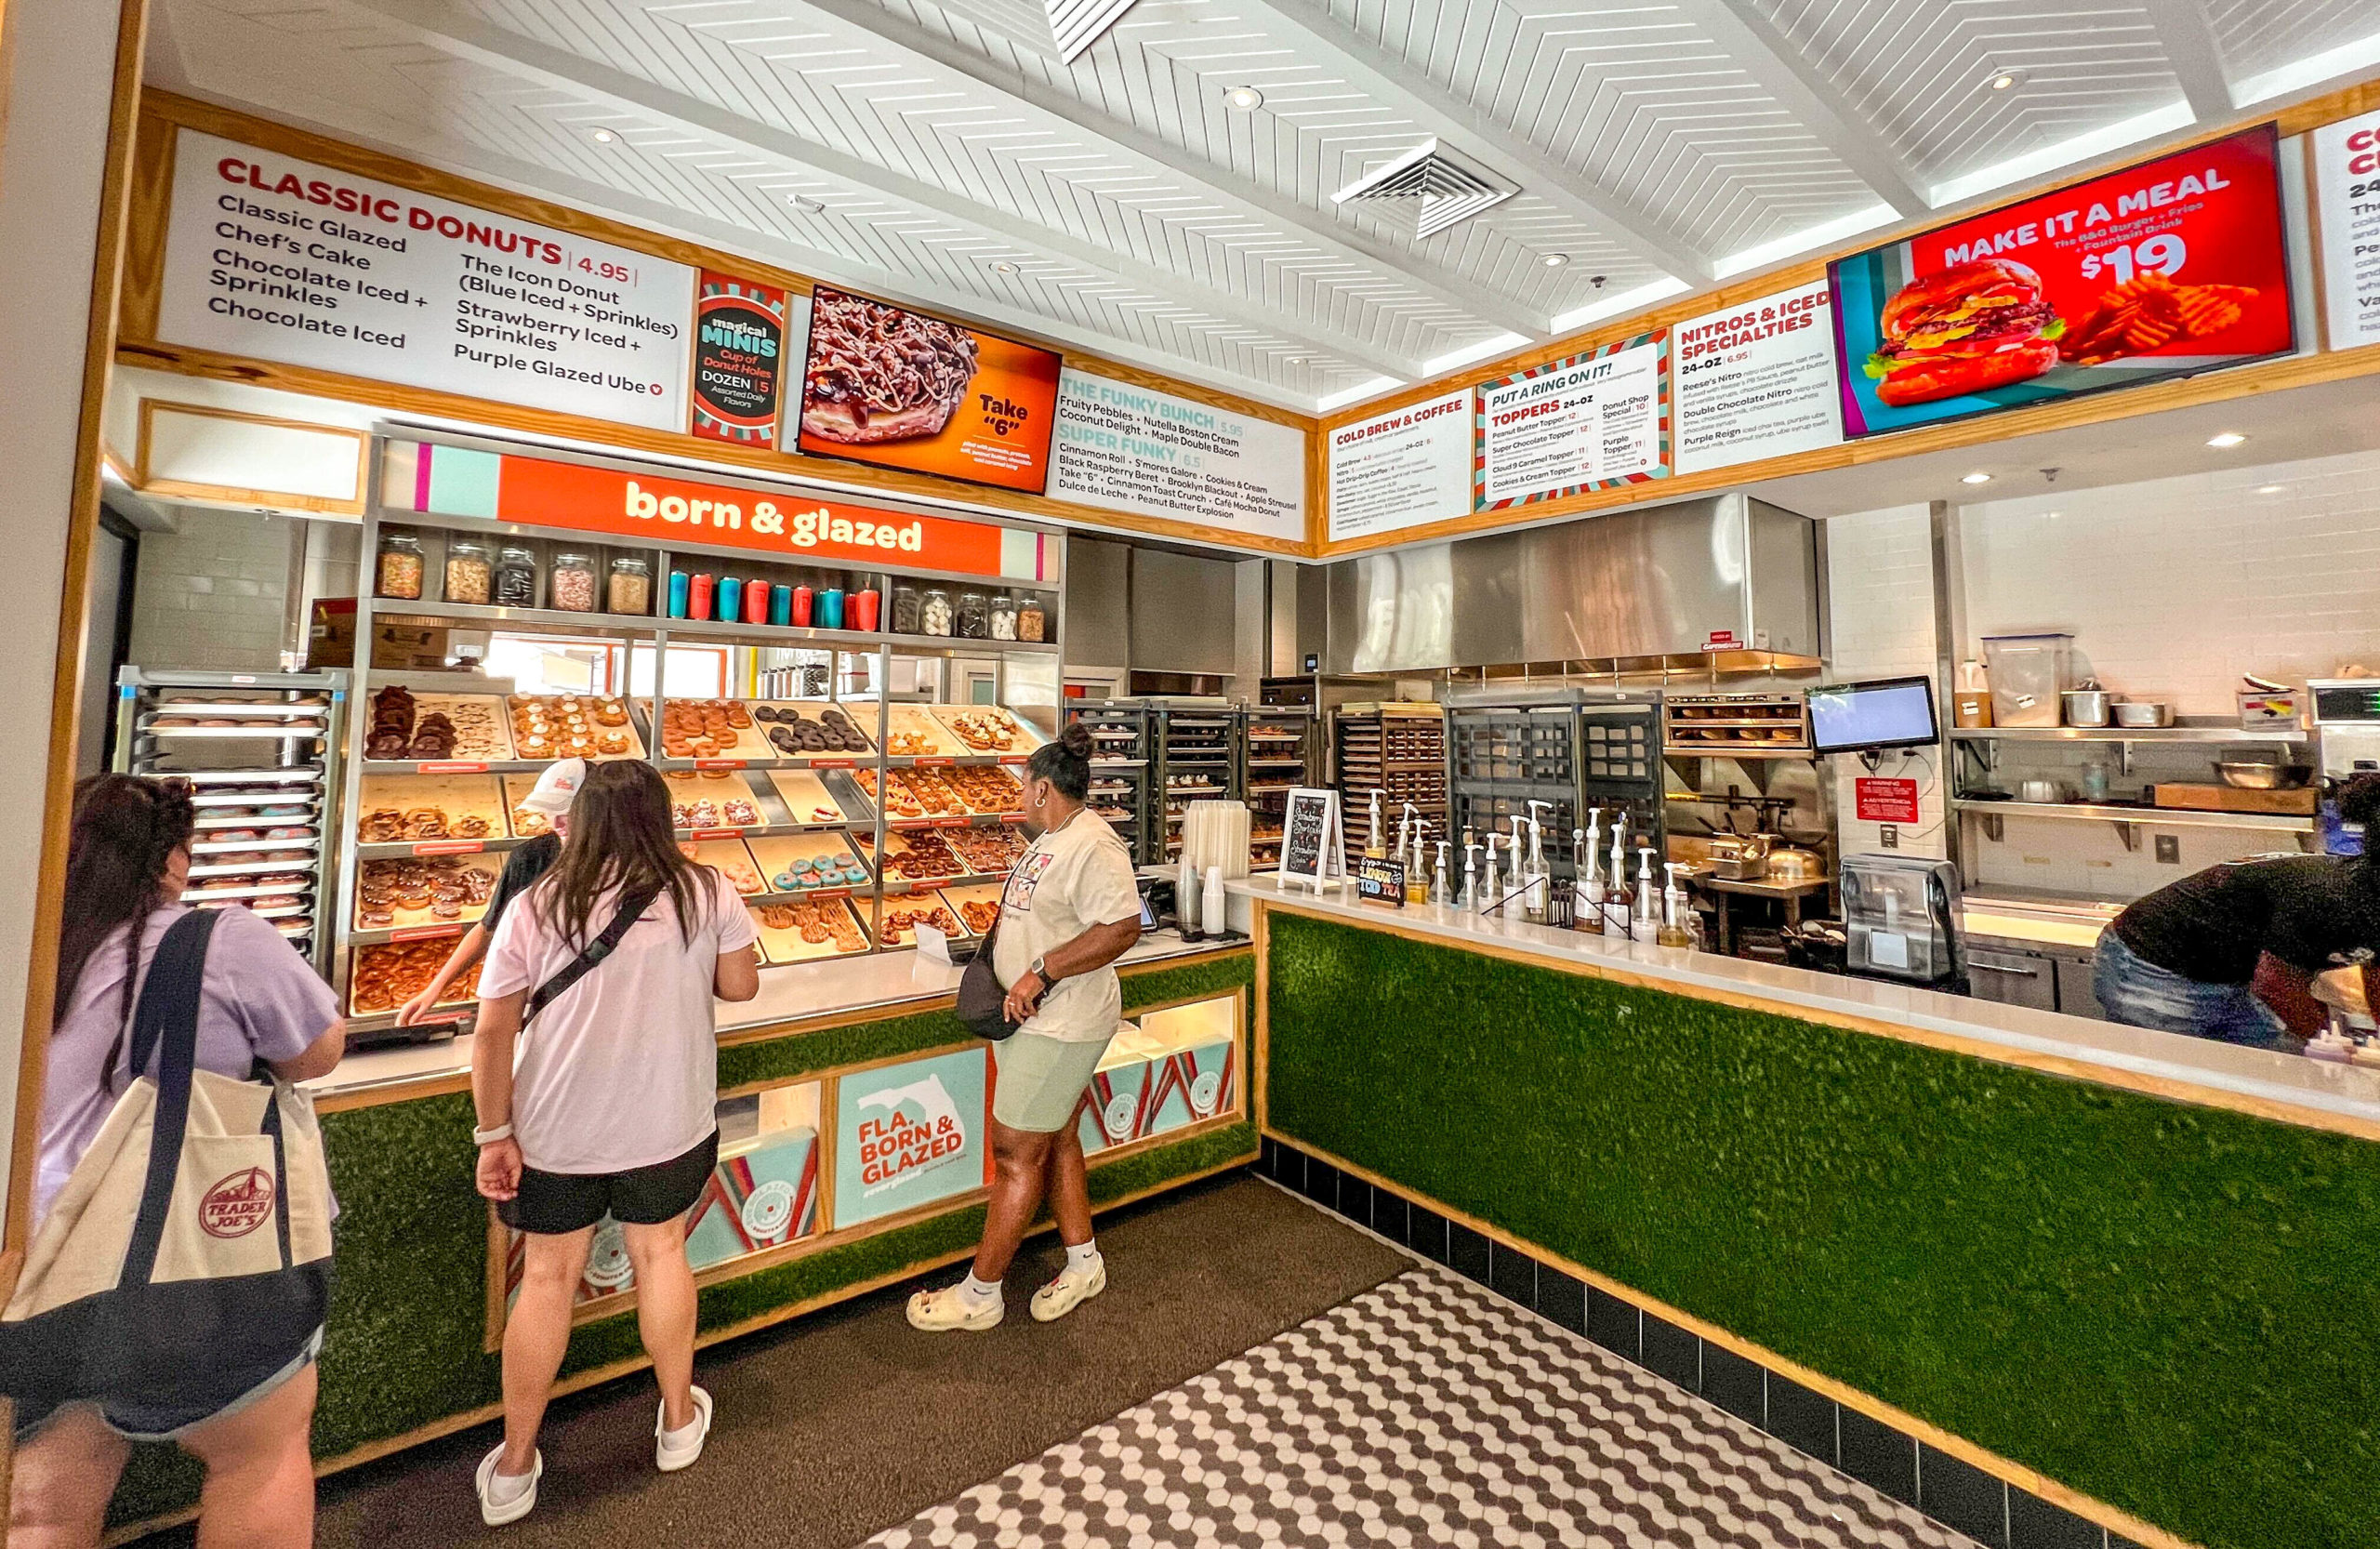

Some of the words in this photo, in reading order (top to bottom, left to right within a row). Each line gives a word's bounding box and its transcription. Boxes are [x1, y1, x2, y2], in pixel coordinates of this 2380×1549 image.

[218, 158, 400, 223] CLASSIC
[409, 207, 562, 264] DONUTS
[578, 258, 628, 282] 4.95
[218, 195, 313, 230] Classic
[320, 219, 406, 253] Glazed
[1945, 222, 2039, 268] MAKE
[2045, 210, 2079, 238] IT
[2085, 203, 2112, 227] A
[2118, 168, 2230, 218] MEAL
[2110, 215, 2156, 233] Burger
[215, 222, 301, 254] Chef's
[308, 244, 371, 269] Cake
[2082, 233, 2187, 285] $19
[210, 270, 337, 308] Sprinkles
[213, 249, 350, 291] Chocolate
[358, 281, 409, 304] Iced
[461, 254, 503, 275] The
[509, 266, 552, 288] Icon
[558, 279, 620, 304] Donut
[208, 298, 347, 337] Chocolate
[353, 325, 405, 349] Iced
[457, 299, 580, 341] Strawberry
[585, 327, 626, 349] Iced
[459, 275, 517, 298] (Blue
[522, 289, 564, 311] Iced
[585, 304, 678, 339] Sprinkles)
[1682, 311, 1756, 345] NITROS
[1761, 308, 1776, 322] &
[1780, 291, 1830, 316] ICED
[456, 319, 557, 351] Sprinkles
[702, 324, 775, 357] MINIS
[712, 319, 767, 336] magical
[1682, 313, 1813, 361] SPECIALTIES
[455, 344, 527, 369] Purple
[532, 360, 602, 385] Glazed
[608, 375, 646, 393] Ube
[704, 357, 739, 372] Donut
[741, 364, 772, 378] Holes
[721, 350, 744, 363] Cup
[1727, 351, 1748, 363] 6.95
[702, 370, 750, 389] DOZEN
[711, 386, 747, 398] Assorted
[747, 392, 765, 403] Daily
[1492, 391, 1518, 407] PUT
[1520, 388, 1528, 399] A
[1531, 377, 1565, 395] RING
[1568, 369, 1590, 384] ON
[1593, 364, 1612, 378] IT!
[1684, 379, 1716, 391] Reese's
[1718, 372, 1742, 383] Nitro
[723, 397, 751, 407] Flavors
[980, 394, 1027, 420] Take
[1062, 377, 1096, 399] THE
[1101, 388, 1157, 414] FUNKY
[1160, 404, 1214, 429] BUNCH
[1221, 422, 1243, 436] 5.95
[1492, 400, 1559, 427] TOPPERS
[1603, 401, 1626, 411] Donut
[1629, 395, 1648, 404] Shop
[1603, 406, 1631, 419] Special
[1684, 404, 1715, 418] Double
[1717, 395, 1765, 411] Chocolate
[1766, 389, 1792, 400] Nitro
[1060, 408, 1104, 427] Coconut
[1106, 419, 1141, 435] Delight
[1152, 430, 1179, 444] Maple
[1181, 437, 1211, 452] Double
[1213, 445, 1239, 457] Bacon
[1061, 395, 1091, 413] Fruity
[1093, 404, 1133, 421] Pebbles
[1144, 417, 1176, 431] Nutella
[1179, 425, 1210, 439] Boston
[1211, 433, 1238, 447] Cream
[1337, 430, 1365, 445] COLD
[1368, 417, 1401, 436] BREW
[1404, 416, 1411, 426] &
[1414, 400, 1462, 422] COFFEE
[1493, 429, 1515, 439] Peanut
[1517, 422, 1539, 432] Butter
[1540, 416, 1565, 427] Topper
[1685, 433, 1713, 445] Purple
[1715, 429, 1740, 440] Reign
[1059, 424, 1117, 450] SUPER
[1122, 438, 1176, 461] FUNKY
[1183, 455, 1200, 468] 6.5
[1493, 445, 1512, 454] Super
[1513, 437, 1547, 448] Chocolate
[1549, 430, 1574, 440] Topper
[1604, 436, 1629, 445] Purple
[1604, 444, 1632, 455] Topper
[1060, 443, 1107, 460] Cinnamon
[1109, 454, 1125, 464] Roll
[1135, 459, 1169, 475] S'mores
[1171, 467, 1197, 479] Galore
[1206, 474, 1236, 488] Cookies
[1244, 483, 1267, 494] Cream
[1493, 463, 1512, 473] Cloud
[1519, 456, 1547, 467] Caramel
[1549, 450, 1574, 460] Topper
[1493, 478, 1518, 487] Cookies
[1526, 471, 1548, 481] Cream
[1550, 466, 1576, 476] Topper
[1059, 480, 1086, 491] Dulce
[1088, 485, 1099, 494] de
[1102, 487, 1128, 499] Leche
[1138, 495, 1167, 507] Peanut
[1170, 500, 1196, 511] Butter
[1197, 505, 1234, 519] Explosion
[1060, 456, 1084, 467] Black
[1087, 461, 1133, 479] Raspberry
[1135, 470, 1157, 483] Beret
[1168, 478, 1203, 492] Brooklyn
[1205, 485, 1238, 498] Blackout
[1246, 494, 1266, 505] Apple
[1268, 497, 1296, 510] Streusel
[1060, 467, 1081, 479] Take
[1107, 477, 1151, 492] Cinnamon
[1154, 485, 1175, 497] Toast
[1178, 491, 1206, 502] Crunch
[1215, 498, 1232, 508] Café
[1234, 502, 1257, 512] Mocha
[1259, 507, 1279, 517] Donut
[626, 481, 741, 530] born
[751, 502, 785, 534] &
[791, 508, 922, 552] glazed
[1360, 866, 1392, 883] LEMON
[859, 1111, 914, 1144] FLA.
[861, 1122, 931, 1164] BORN
[937, 1116, 953, 1134] &
[863, 1132, 961, 1185] GLAZED
[208, 1215, 257, 1228] JOE'S
[209, 1202, 266, 1215] TRADER
